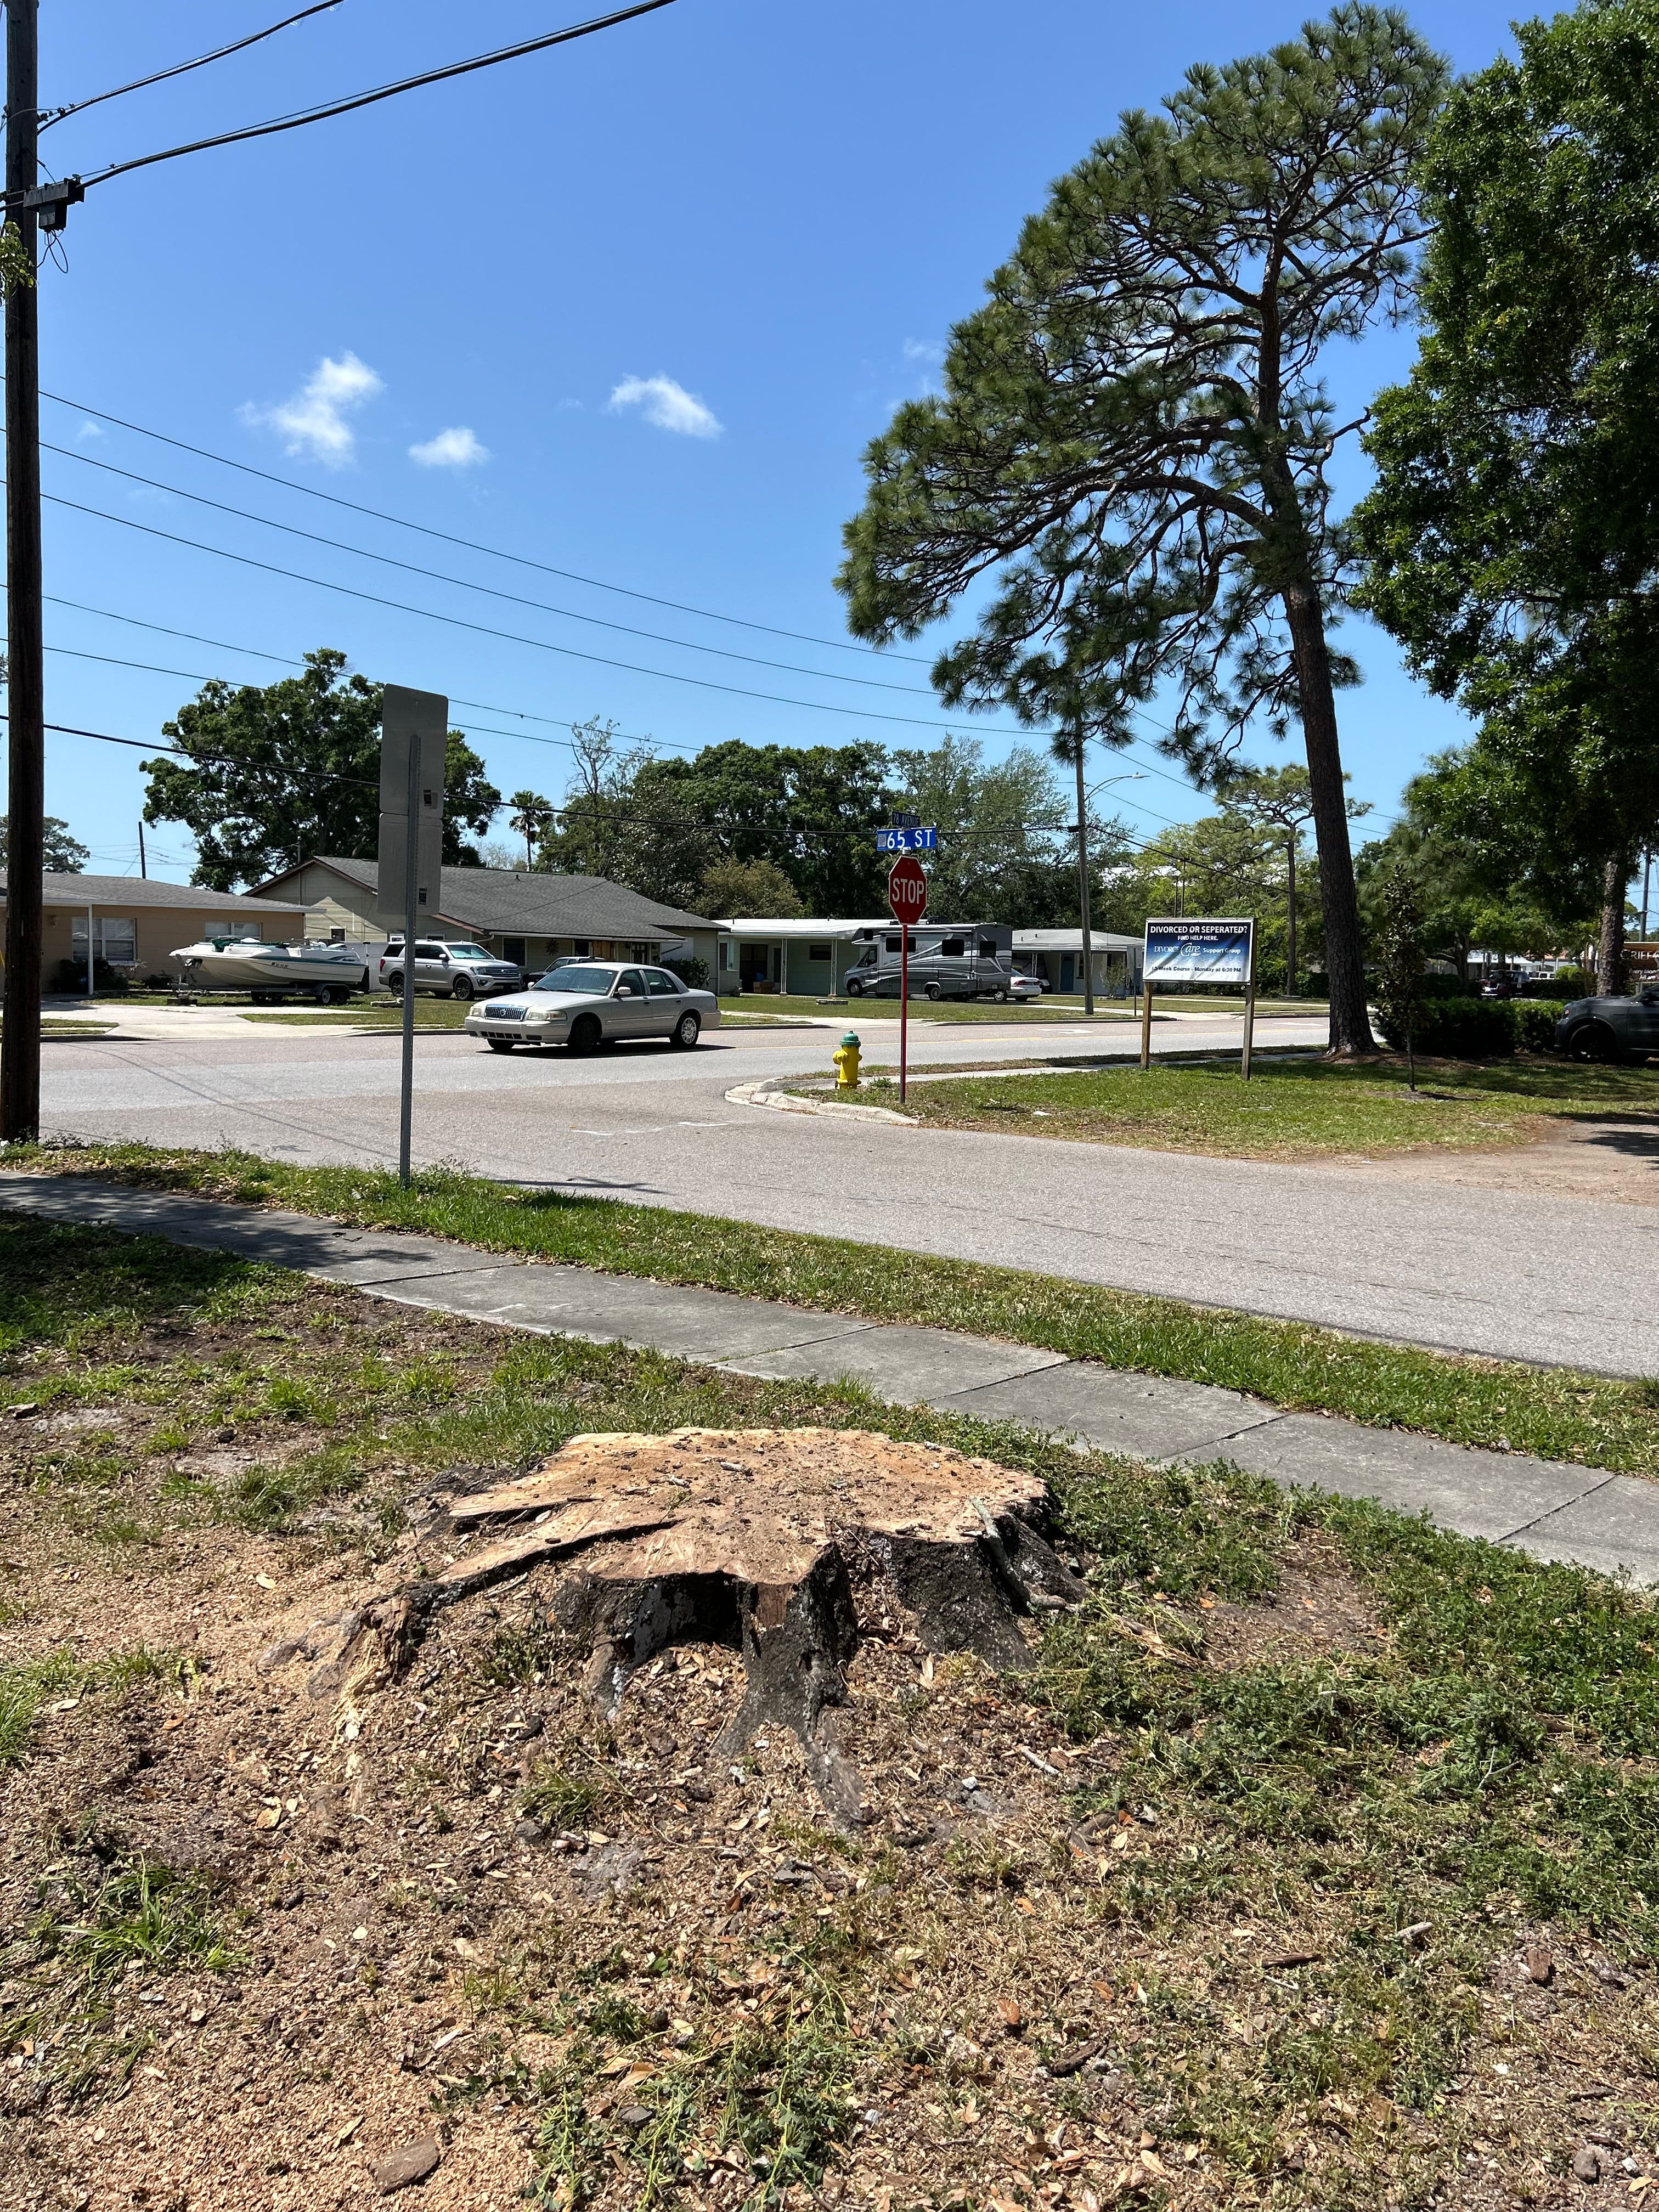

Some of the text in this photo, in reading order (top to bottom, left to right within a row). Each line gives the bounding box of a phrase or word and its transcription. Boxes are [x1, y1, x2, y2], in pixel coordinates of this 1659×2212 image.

[893, 813, 919, 827] 78 AVENUE
[887, 830, 932, 849] 65 ST
[892, 878, 924, 904] STOP
